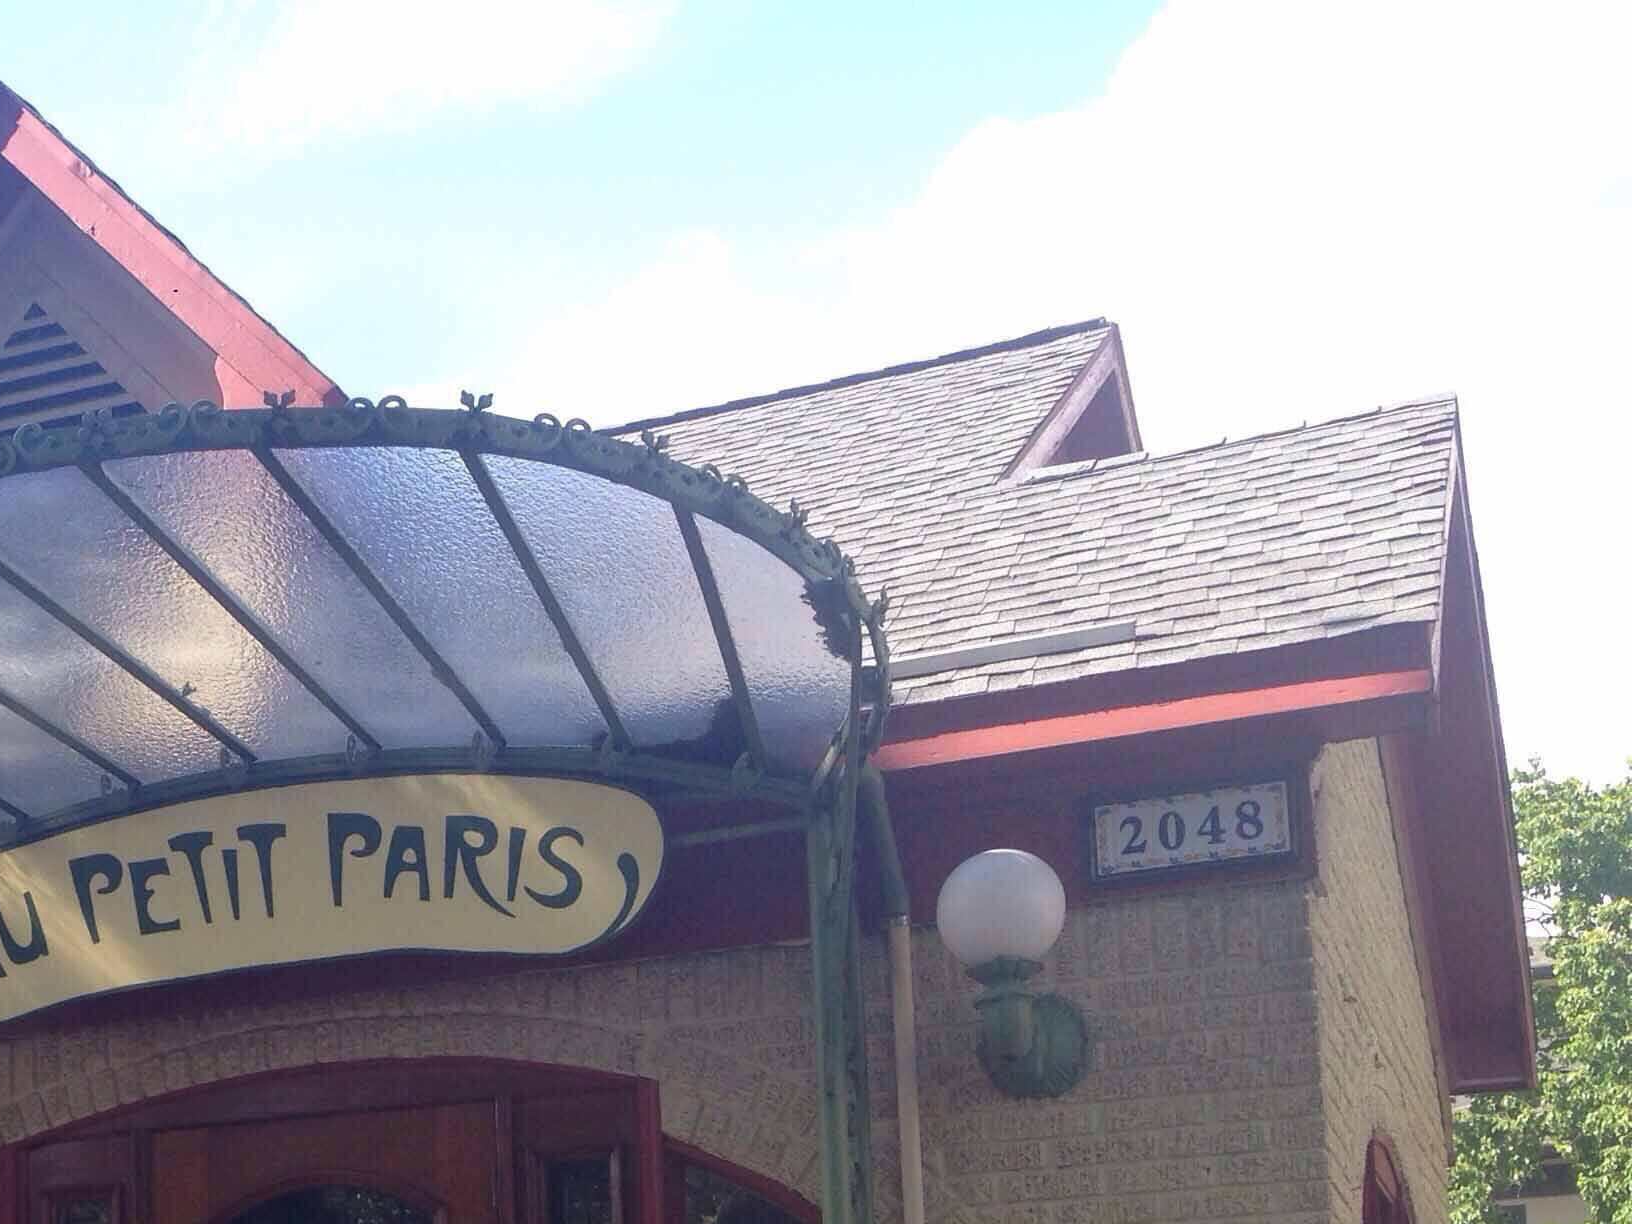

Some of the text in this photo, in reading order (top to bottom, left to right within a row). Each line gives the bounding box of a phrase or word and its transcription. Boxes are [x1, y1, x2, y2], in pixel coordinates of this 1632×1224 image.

[1119, 800, 1264, 855] 2048
[69, 823, 287, 945] PETIT
[327, 812, 584, 919] PARIS
